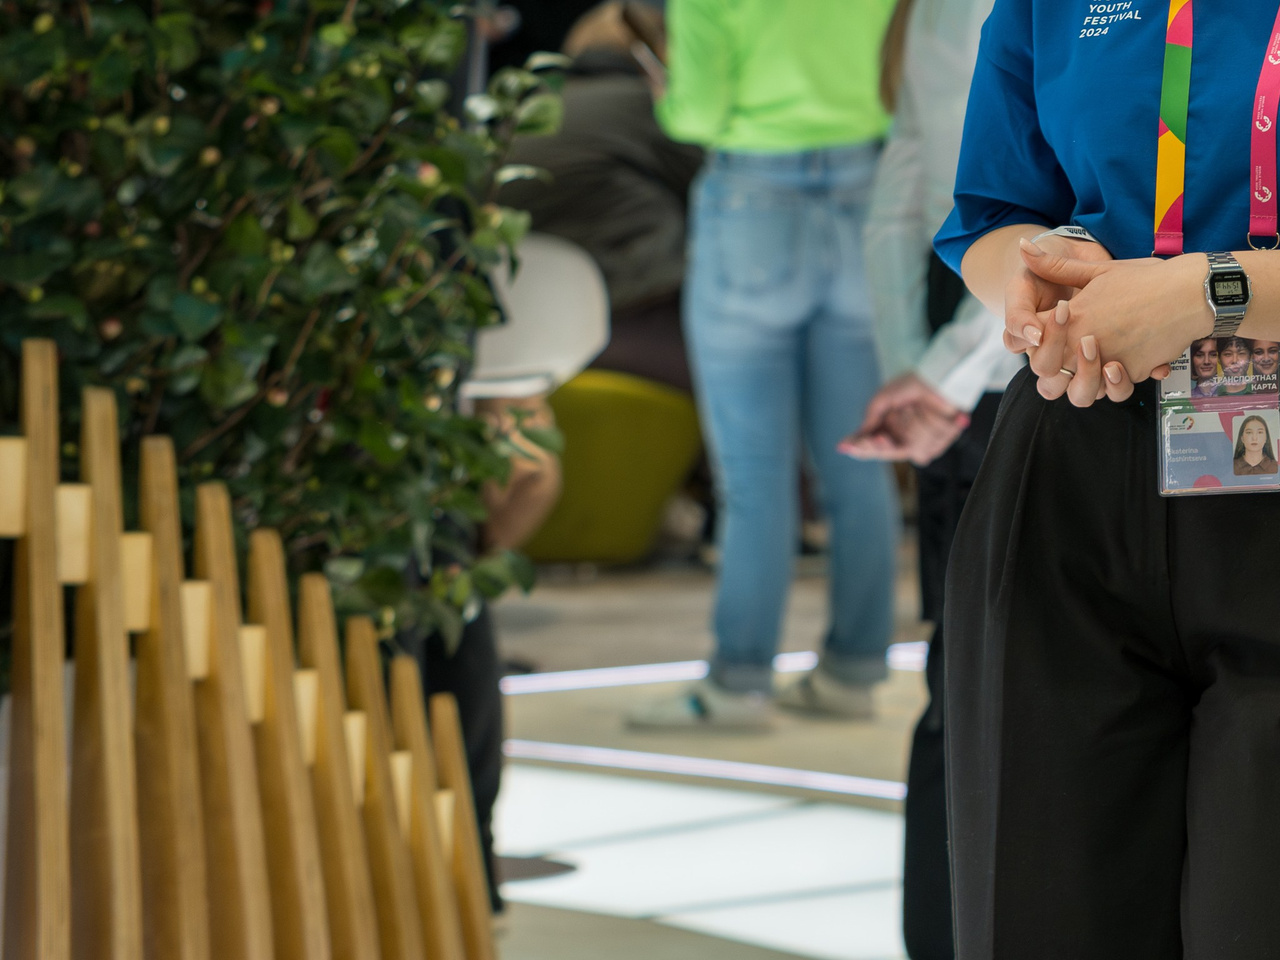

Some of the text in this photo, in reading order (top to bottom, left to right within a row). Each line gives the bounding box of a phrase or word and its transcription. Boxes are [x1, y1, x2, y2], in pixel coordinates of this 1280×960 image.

[1089, 1, 1132, 13] YOUTH
[1083, 10, 1142, 26] FESTIVAL
[1079, 27, 1109, 39] 2024
[1212, 374, 1277, 384] ТРАНСПОРТНАЯ
[1251, 383, 1278, 391] КАРТА
